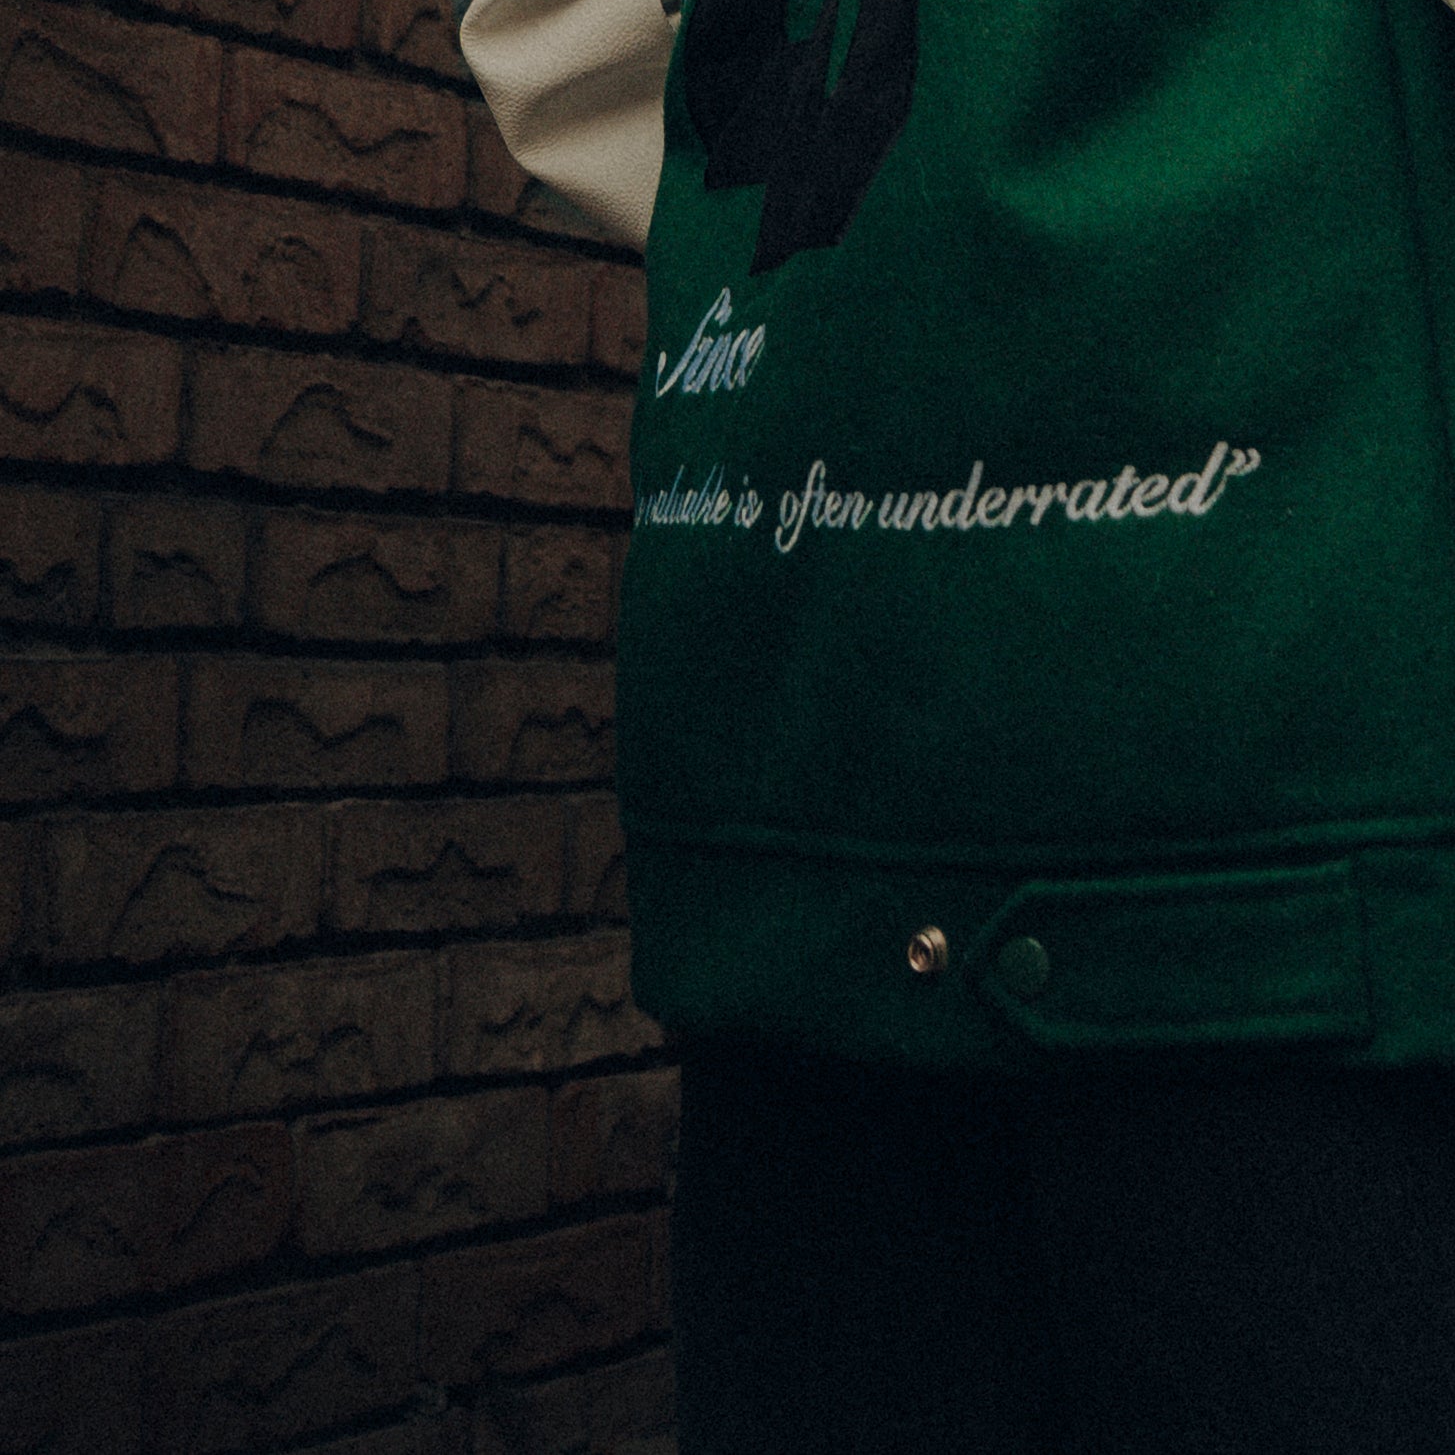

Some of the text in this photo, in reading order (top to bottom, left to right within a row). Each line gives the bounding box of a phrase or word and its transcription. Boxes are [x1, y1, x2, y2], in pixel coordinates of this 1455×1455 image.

[655, 285, 767, 399] Since
[734, 474, 764, 529] is
[774, 458, 874, 554] often
